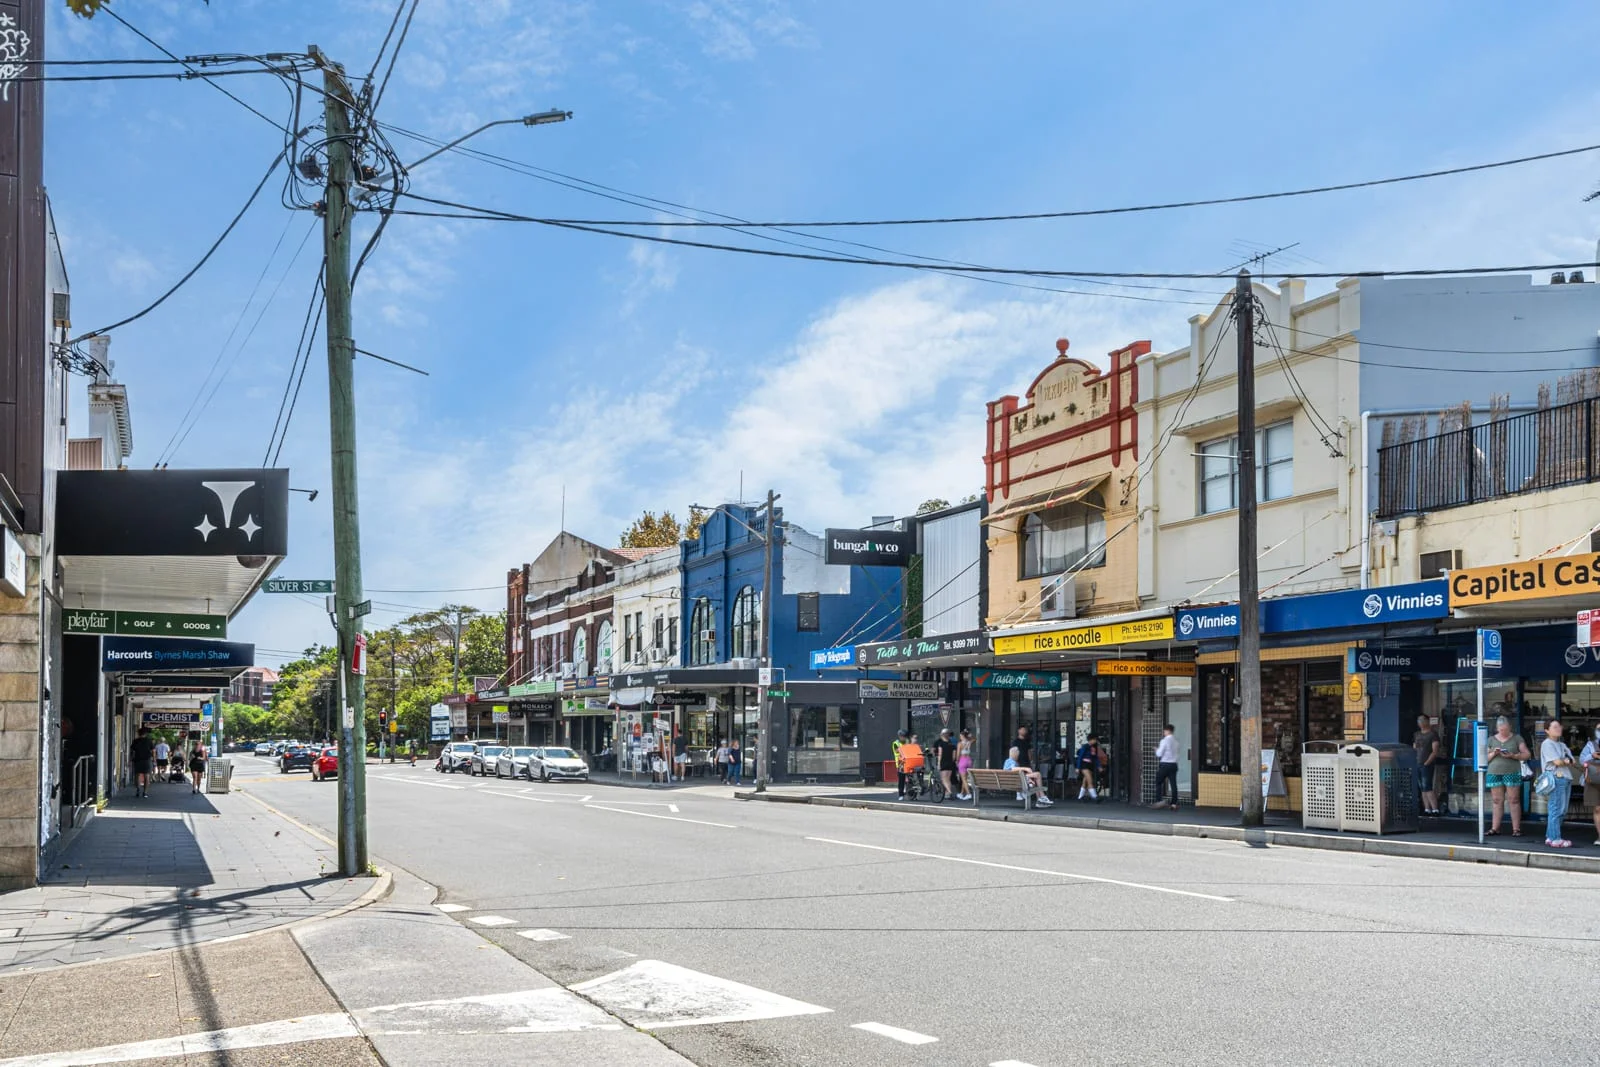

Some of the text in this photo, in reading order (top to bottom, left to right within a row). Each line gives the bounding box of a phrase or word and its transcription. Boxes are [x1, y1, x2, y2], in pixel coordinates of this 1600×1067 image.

[885, 543, 899, 552] co
[269, 581, 313, 591] SILVER ST
[1453, 562, 1546, 599] Capital
[1386, 593, 1443, 611] Vinnies
[68, 611, 109, 630] playfair
[183, 622, 210, 630] GOODS
[1197, 614, 1237, 628] Vinnies
[1132, 624, 1147, 633] 9415
[1148, 622, 1164, 632] 2190
[1034, 629, 1101, 649] rice & noodle
[107, 650, 230, 662] Harcourts Byrnes Marsh Shaw
[876, 646, 898, 660] Taste
[902, 644, 912, 657] of
[917, 641, 939, 655] Thai
[1375, 654, 1411, 666] Vinnies
[1113, 664, 1128, 672] rice
[1135, 664, 1162, 673] noodle
[991, 673, 1014, 684] Taste
[1015, 672, 1027, 686] of
[150, 713, 193, 722] CHEMIST
